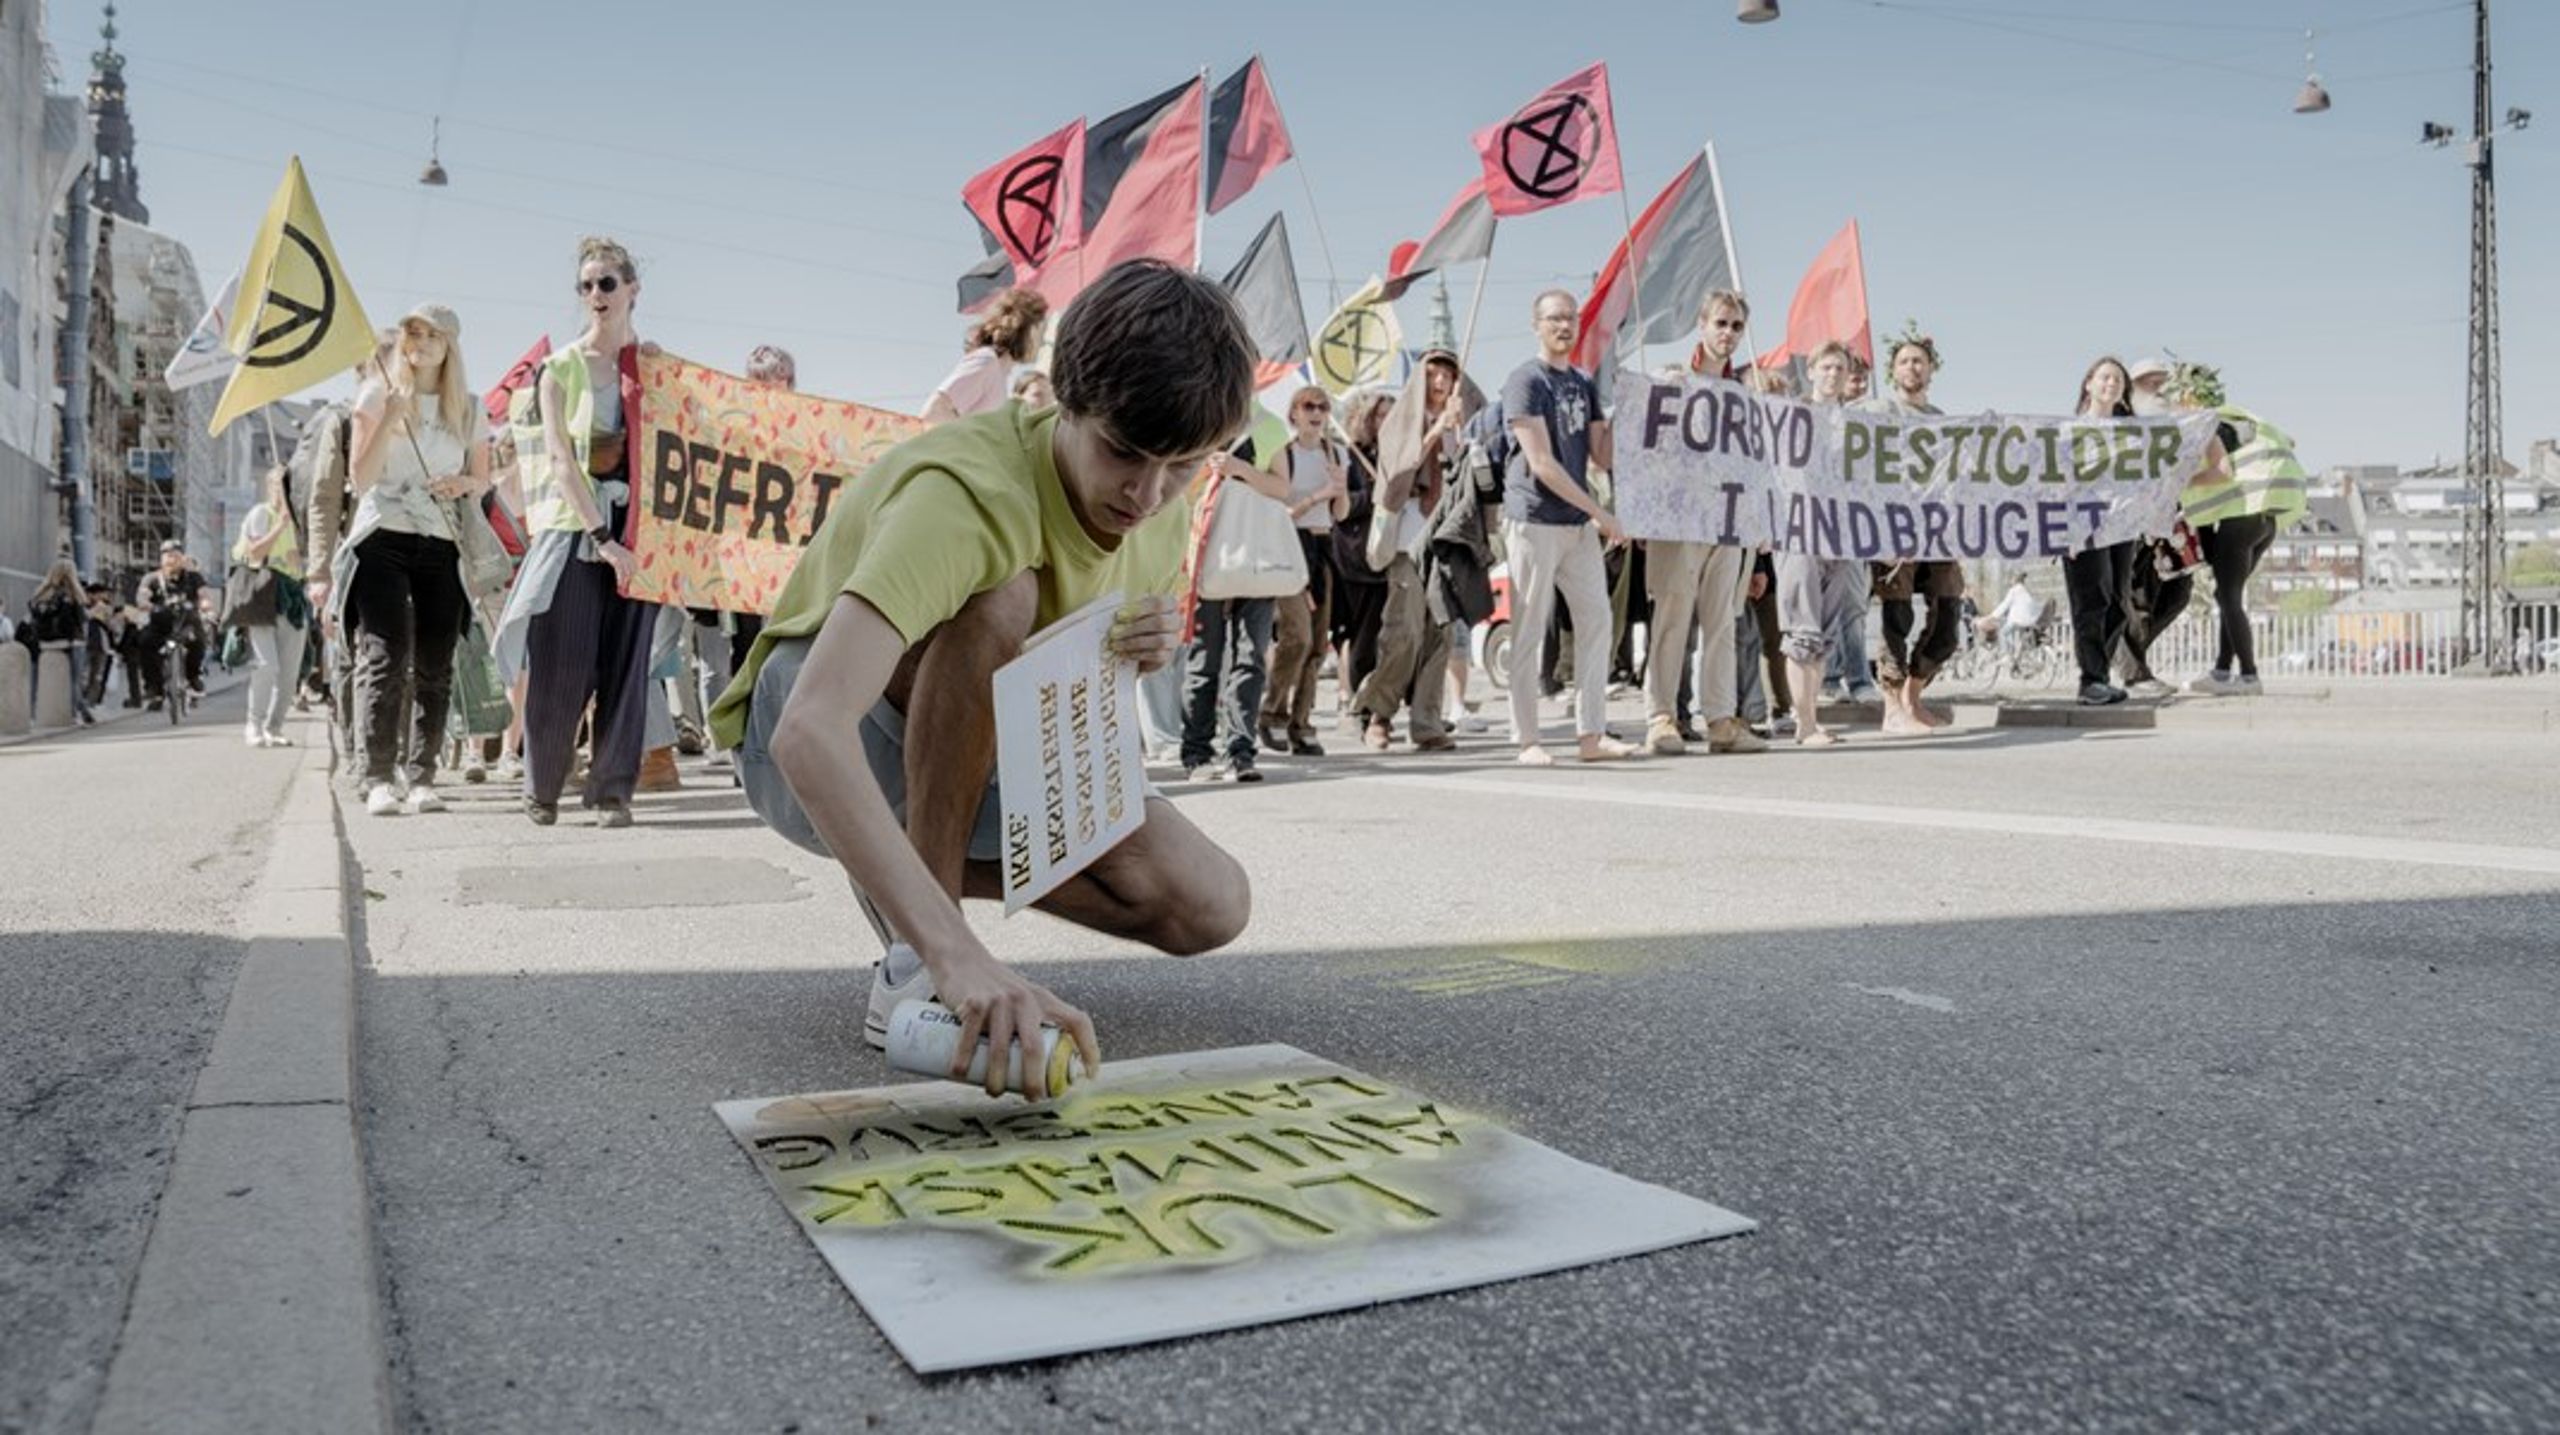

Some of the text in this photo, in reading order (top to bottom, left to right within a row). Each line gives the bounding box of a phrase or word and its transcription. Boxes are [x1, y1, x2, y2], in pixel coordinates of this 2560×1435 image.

[1643, 384, 2183, 486] FORBYD PESTICIDER
[1717, 482, 2111, 559] I LANDBRUGET
[999, 1171, 1441, 1269] LUK
